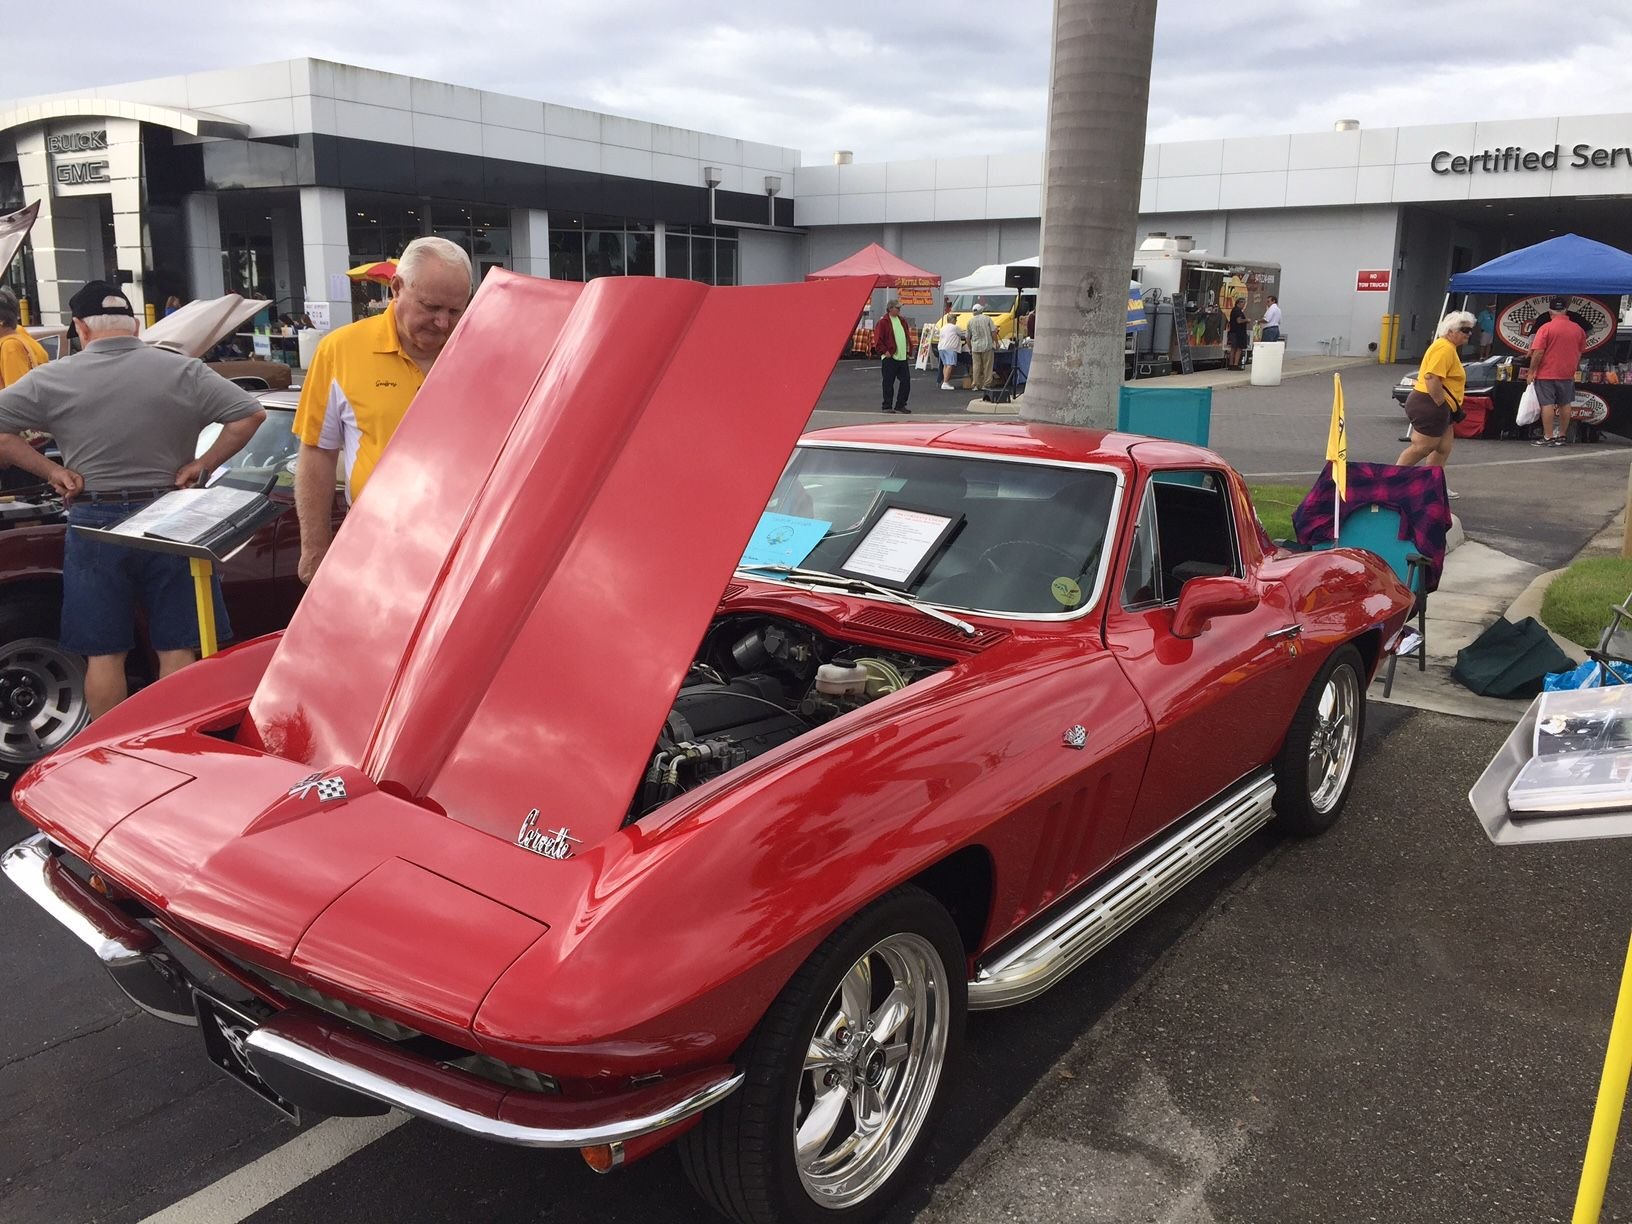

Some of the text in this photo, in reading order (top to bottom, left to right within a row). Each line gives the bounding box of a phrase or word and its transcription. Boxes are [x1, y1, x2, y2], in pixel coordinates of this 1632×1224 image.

[48, 130, 107, 153] BUICK
[57, 161, 109, 184] GMC
[1431, 145, 1560, 174] Certified
[514, 808, 583, 859] Corvette
